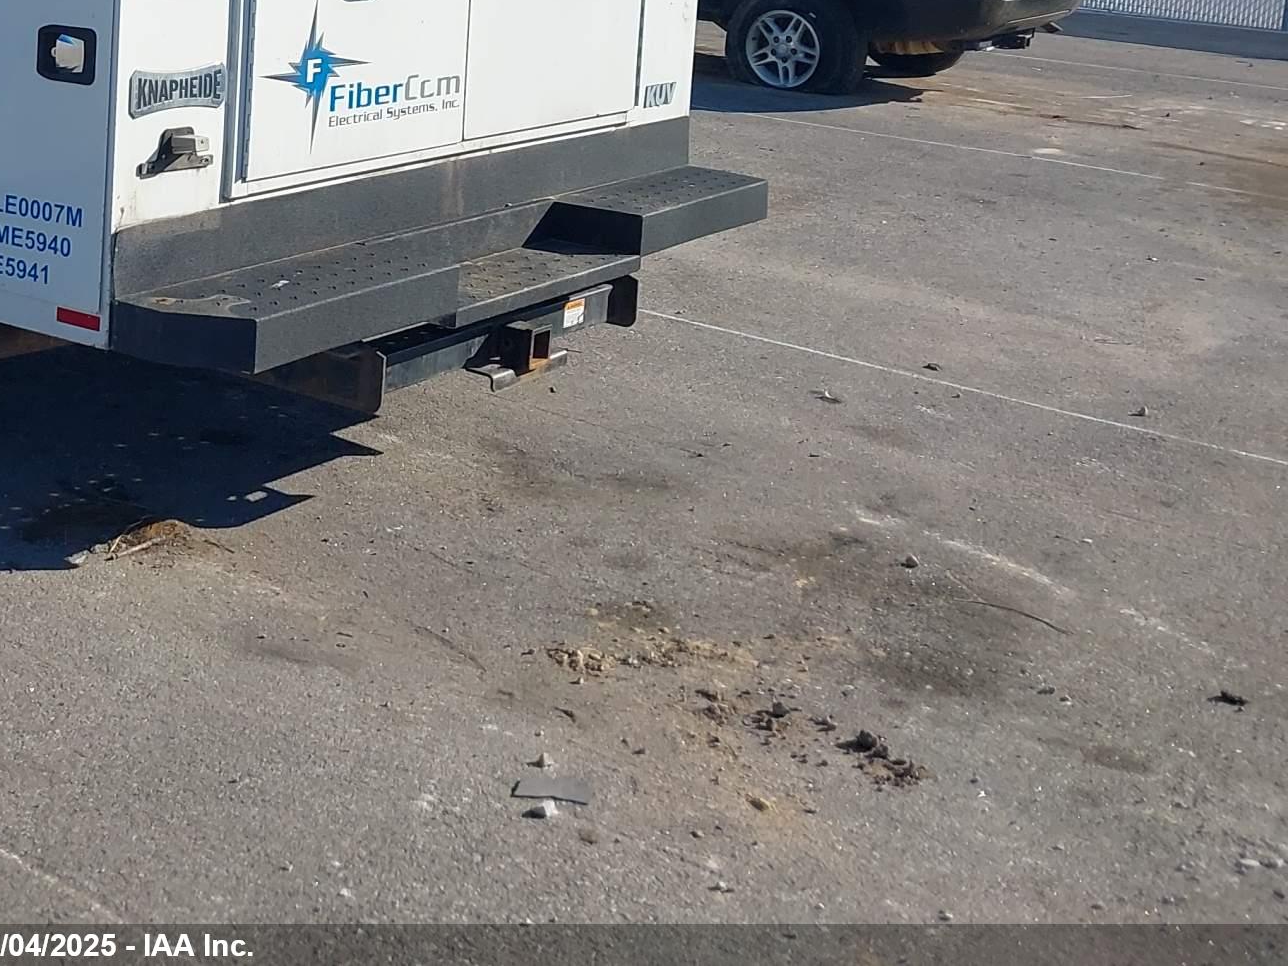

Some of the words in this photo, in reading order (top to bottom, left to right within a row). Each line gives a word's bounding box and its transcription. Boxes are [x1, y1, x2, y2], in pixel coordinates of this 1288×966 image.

[306, 58, 322, 83] F
[136, 71, 224, 111] KNAPHEIDE
[643, 82, 677, 108] KUV
[328, 108, 383, 128] Electrical
[386, 100, 439, 121] Systems,
[442, 97, 460, 110] Inc.
